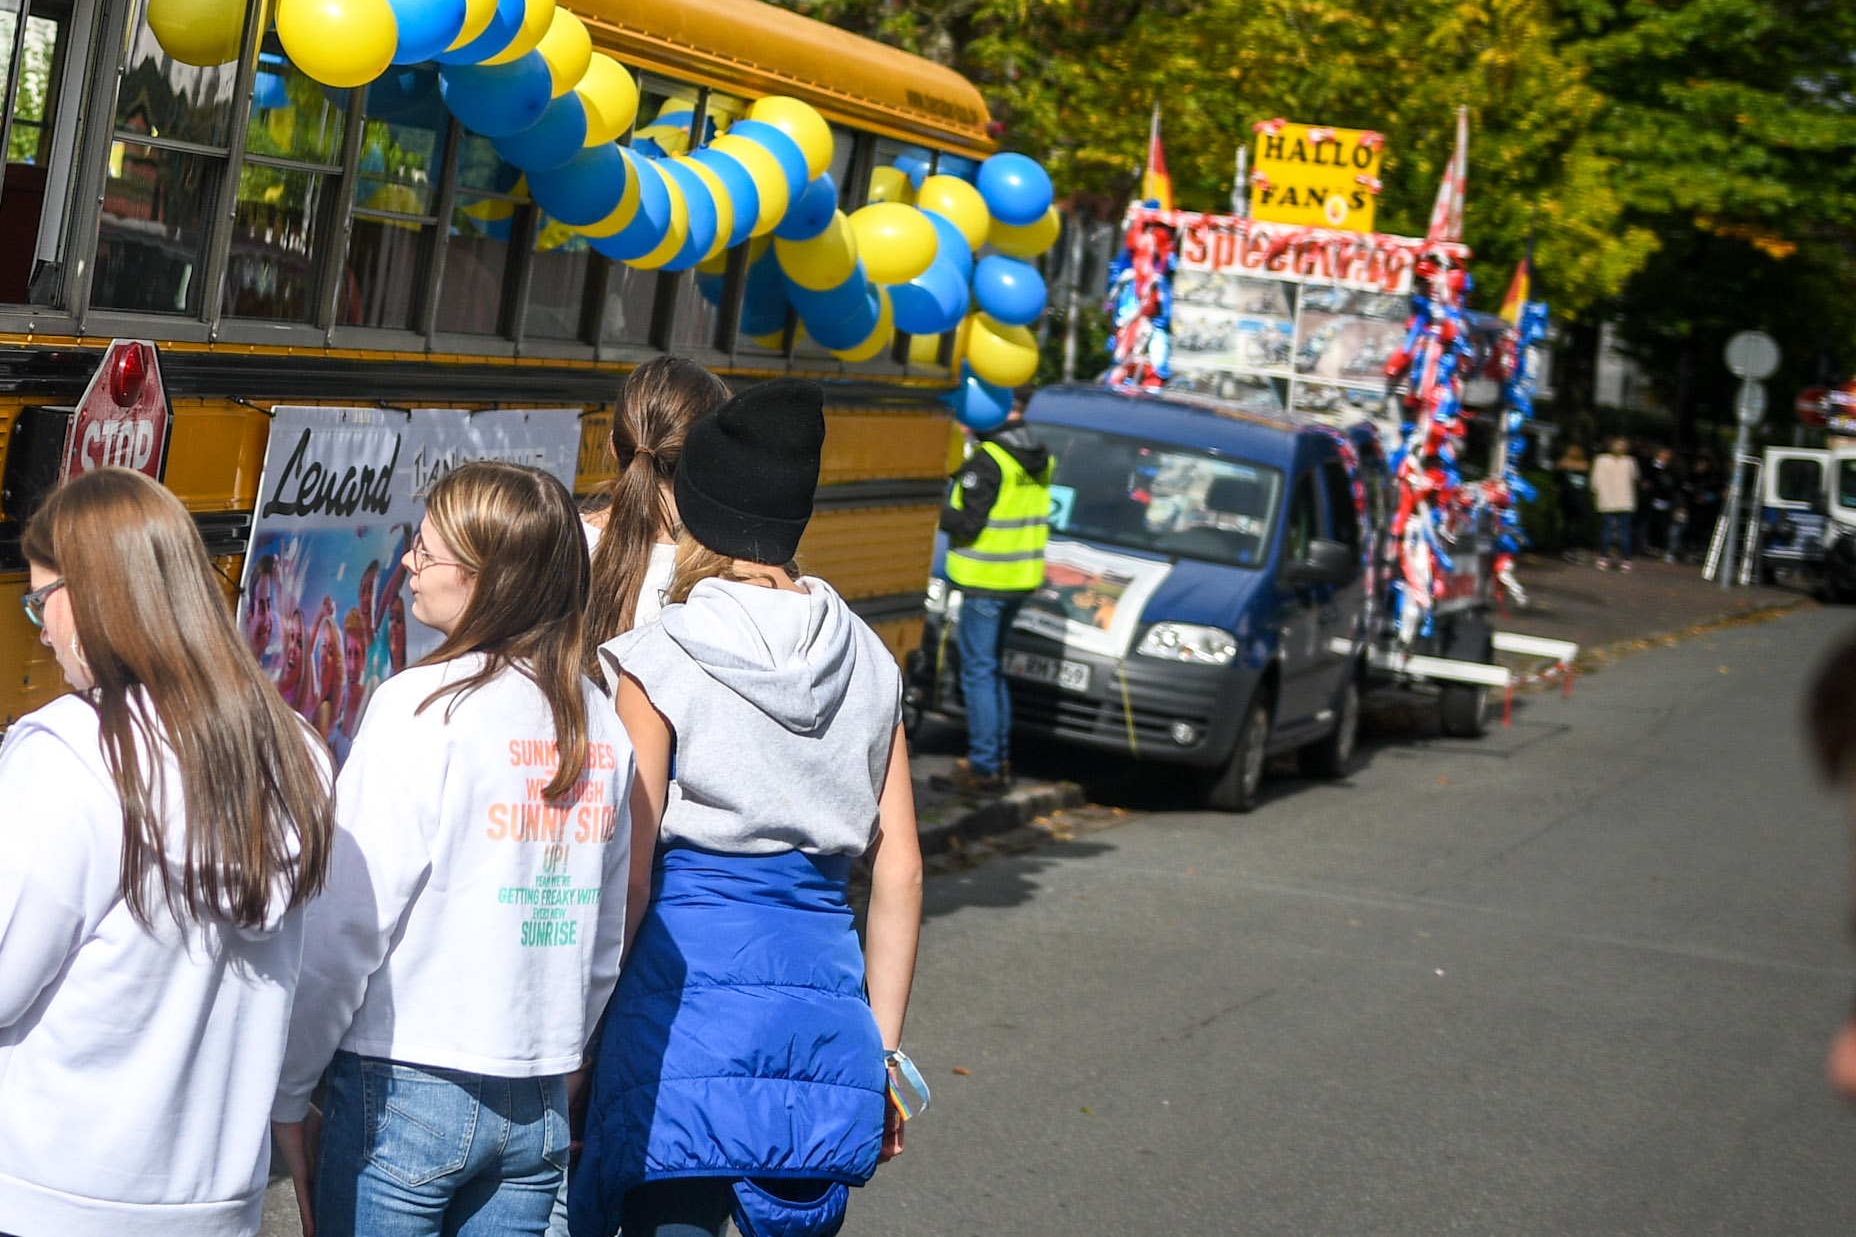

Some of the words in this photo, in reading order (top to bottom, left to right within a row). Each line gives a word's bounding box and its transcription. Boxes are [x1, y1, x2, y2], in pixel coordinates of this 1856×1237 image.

[1264, 134, 1373, 170] HALLO
[81, 419, 154, 471] STOP
[263, 428, 402, 519] Lenard
[508, 739, 558, 768] SUNN
[486, 803, 571, 843] SUNNY
[543, 845, 570, 874] UP!
[498, 887, 540, 905] GETTING
[541, 888, 576, 906] FREAKY
[520, 920, 578, 947] SUNRISE
